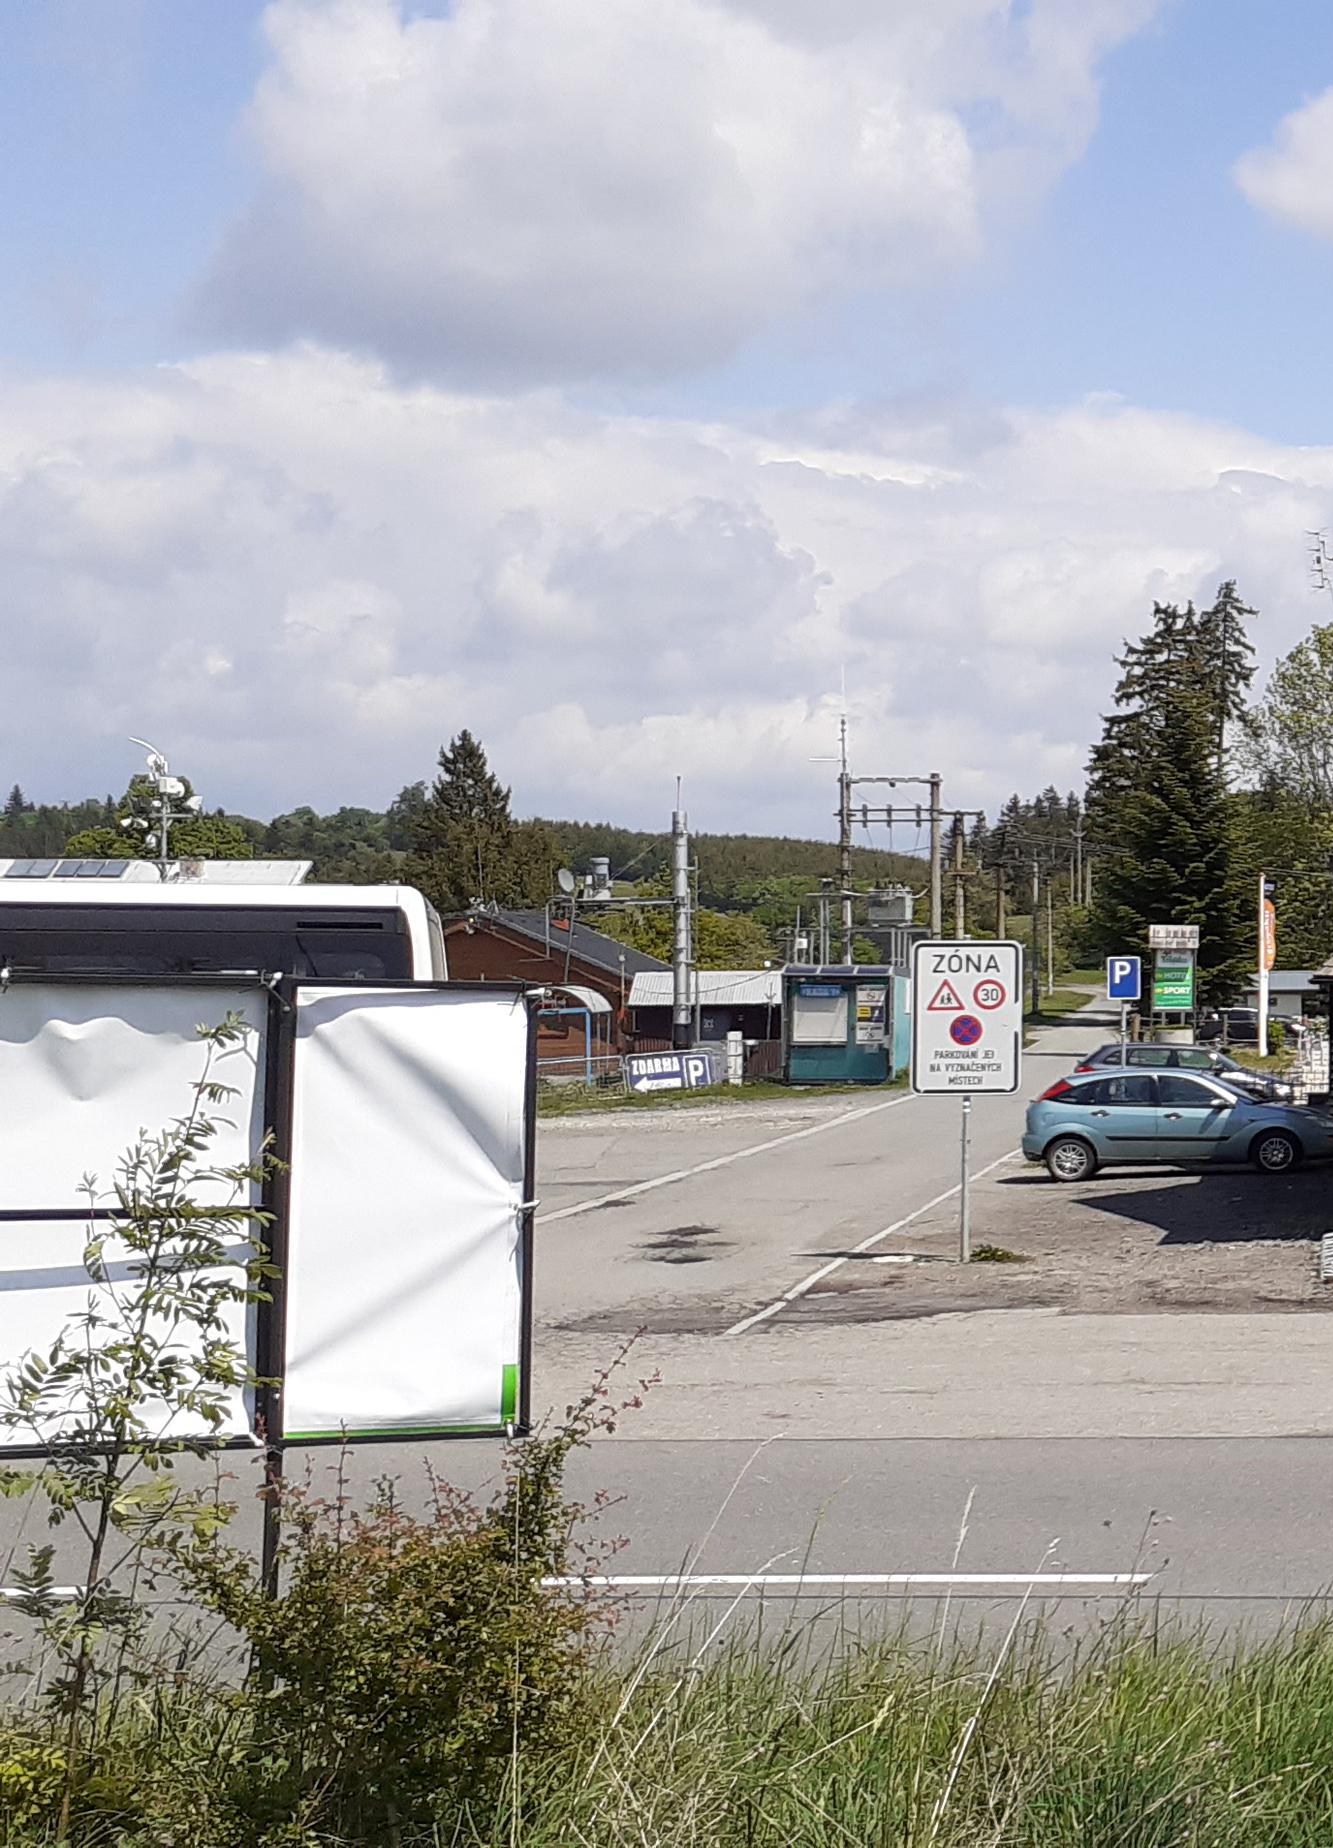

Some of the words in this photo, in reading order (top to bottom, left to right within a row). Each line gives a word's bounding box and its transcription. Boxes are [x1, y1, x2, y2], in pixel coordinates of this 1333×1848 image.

[932, 949, 1001, 973] ZÓNA
[1113, 961, 1131, 984] P
[981, 988, 999, 1002] 30
[631, 1057, 680, 1076] ZDARMA
[688, 1060, 704, 1086] P
[930, 1063, 941, 1073] NA
[945, 1061, 1002, 1073] VYZNAČENÝCH
[948, 1074, 984, 1086] MÍSTECH
